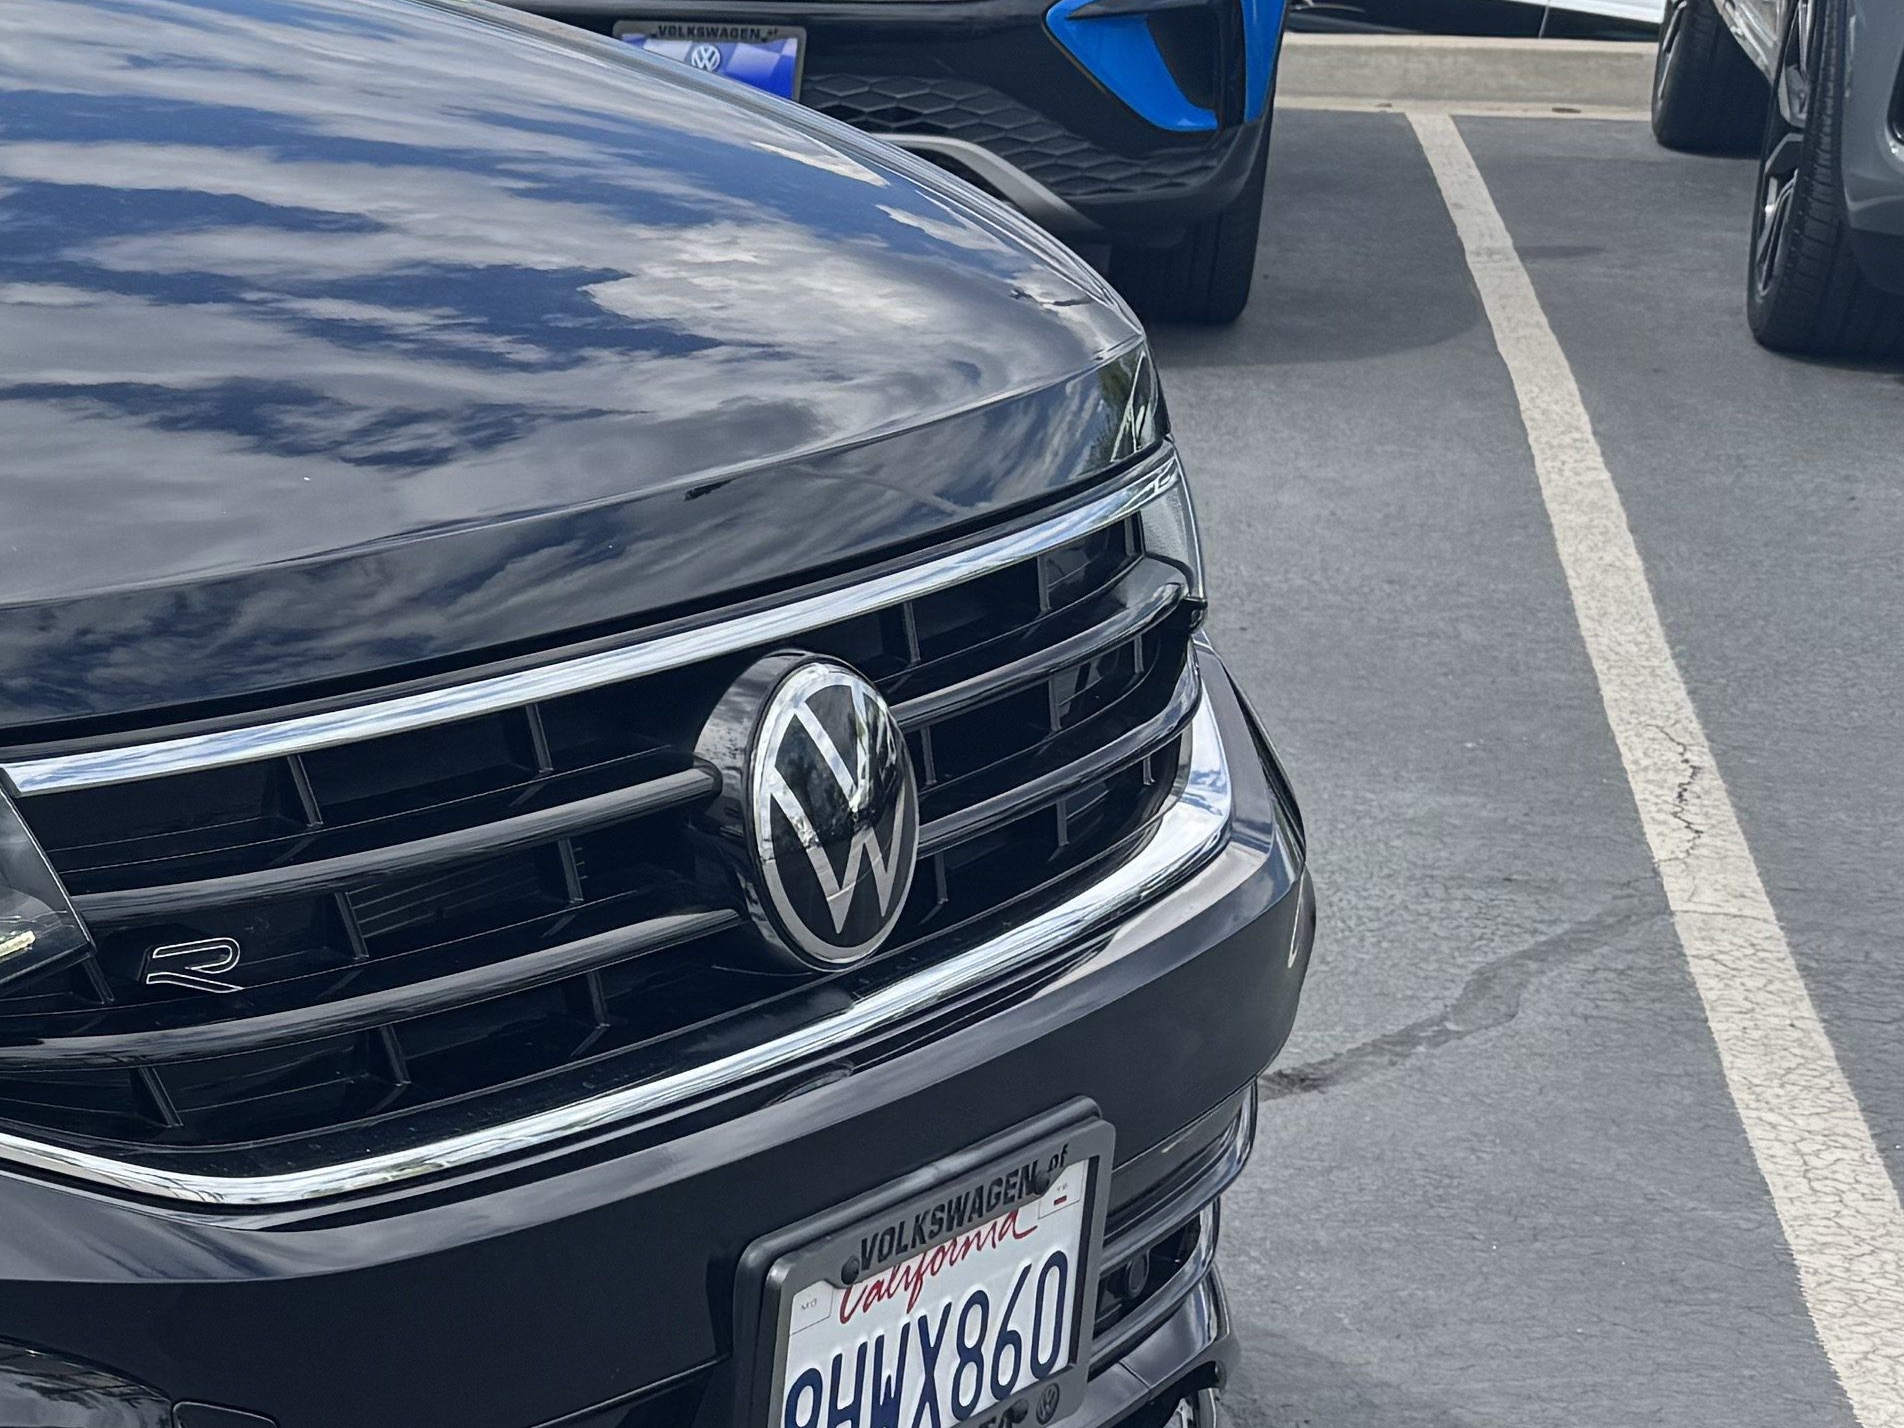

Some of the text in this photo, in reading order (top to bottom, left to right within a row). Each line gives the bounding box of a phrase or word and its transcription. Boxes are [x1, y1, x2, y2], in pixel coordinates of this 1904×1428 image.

[657, 25, 762, 39] VOLKSWAGEN
[146, 937, 244, 994] R
[860, 1159, 1038, 1272] VOLKSWAGEN
[839, 1210, 1038, 1324] California
